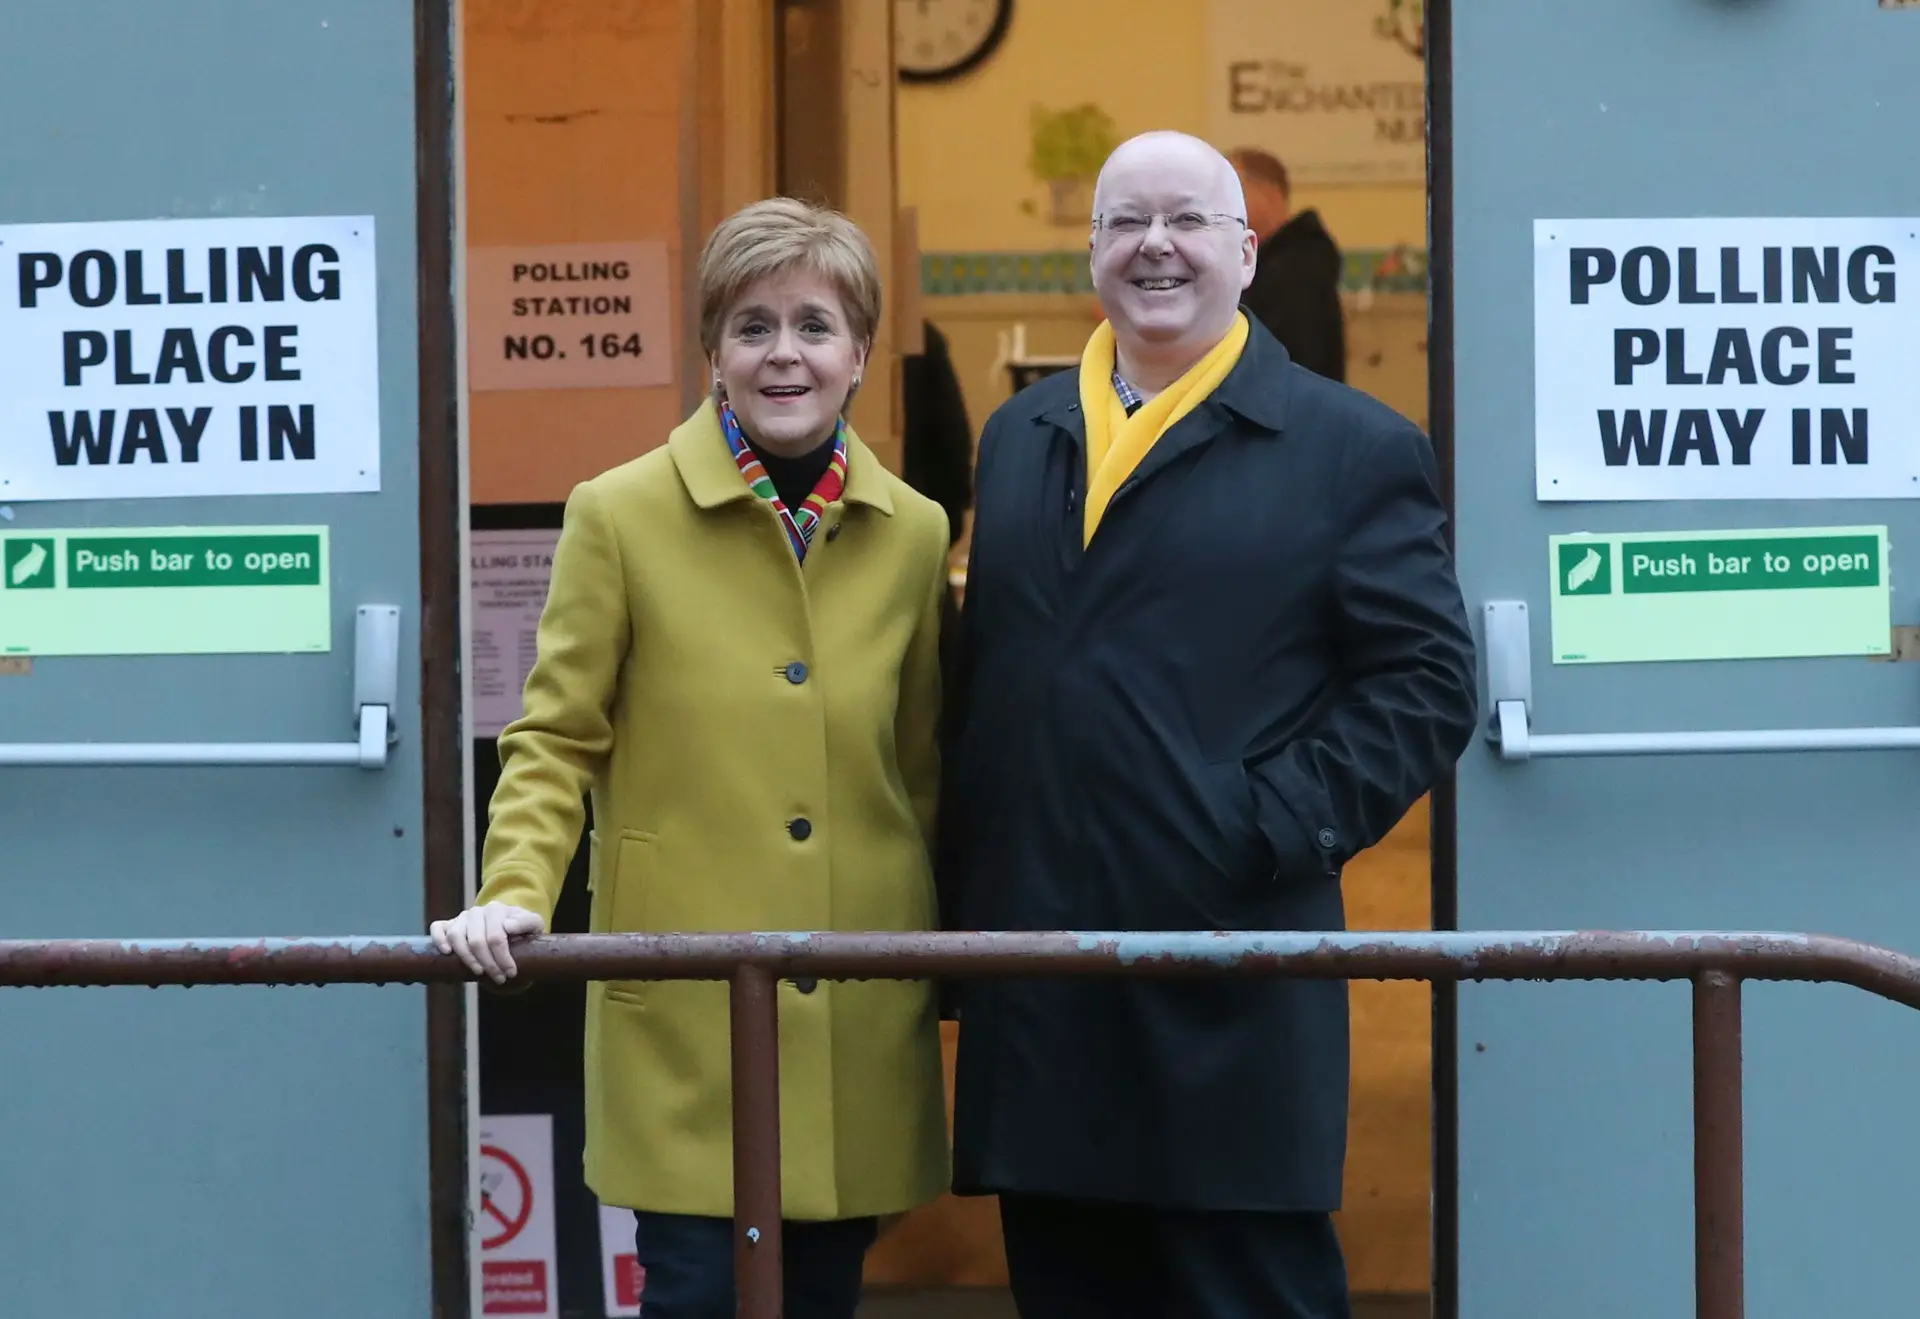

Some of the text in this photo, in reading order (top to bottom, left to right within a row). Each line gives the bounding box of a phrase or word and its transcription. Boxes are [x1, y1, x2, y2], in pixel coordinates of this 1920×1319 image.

[18, 243, 341, 309] POLLING
[513, 261, 630, 282] POLLING
[1569, 244, 1896, 306] POLLING
[513, 295, 631, 317] STATION
[62, 325, 301, 387] PLACE
[504, 332, 642, 360] NO. 164
[1613, 326, 1856, 386] PLACE
[47, 404, 316, 466] WAY IN
[1596, 407, 1869, 467] WAY IN
[76, 549, 311, 574] Push bar to open
[1632, 551, 1869, 577] Push bar to open
